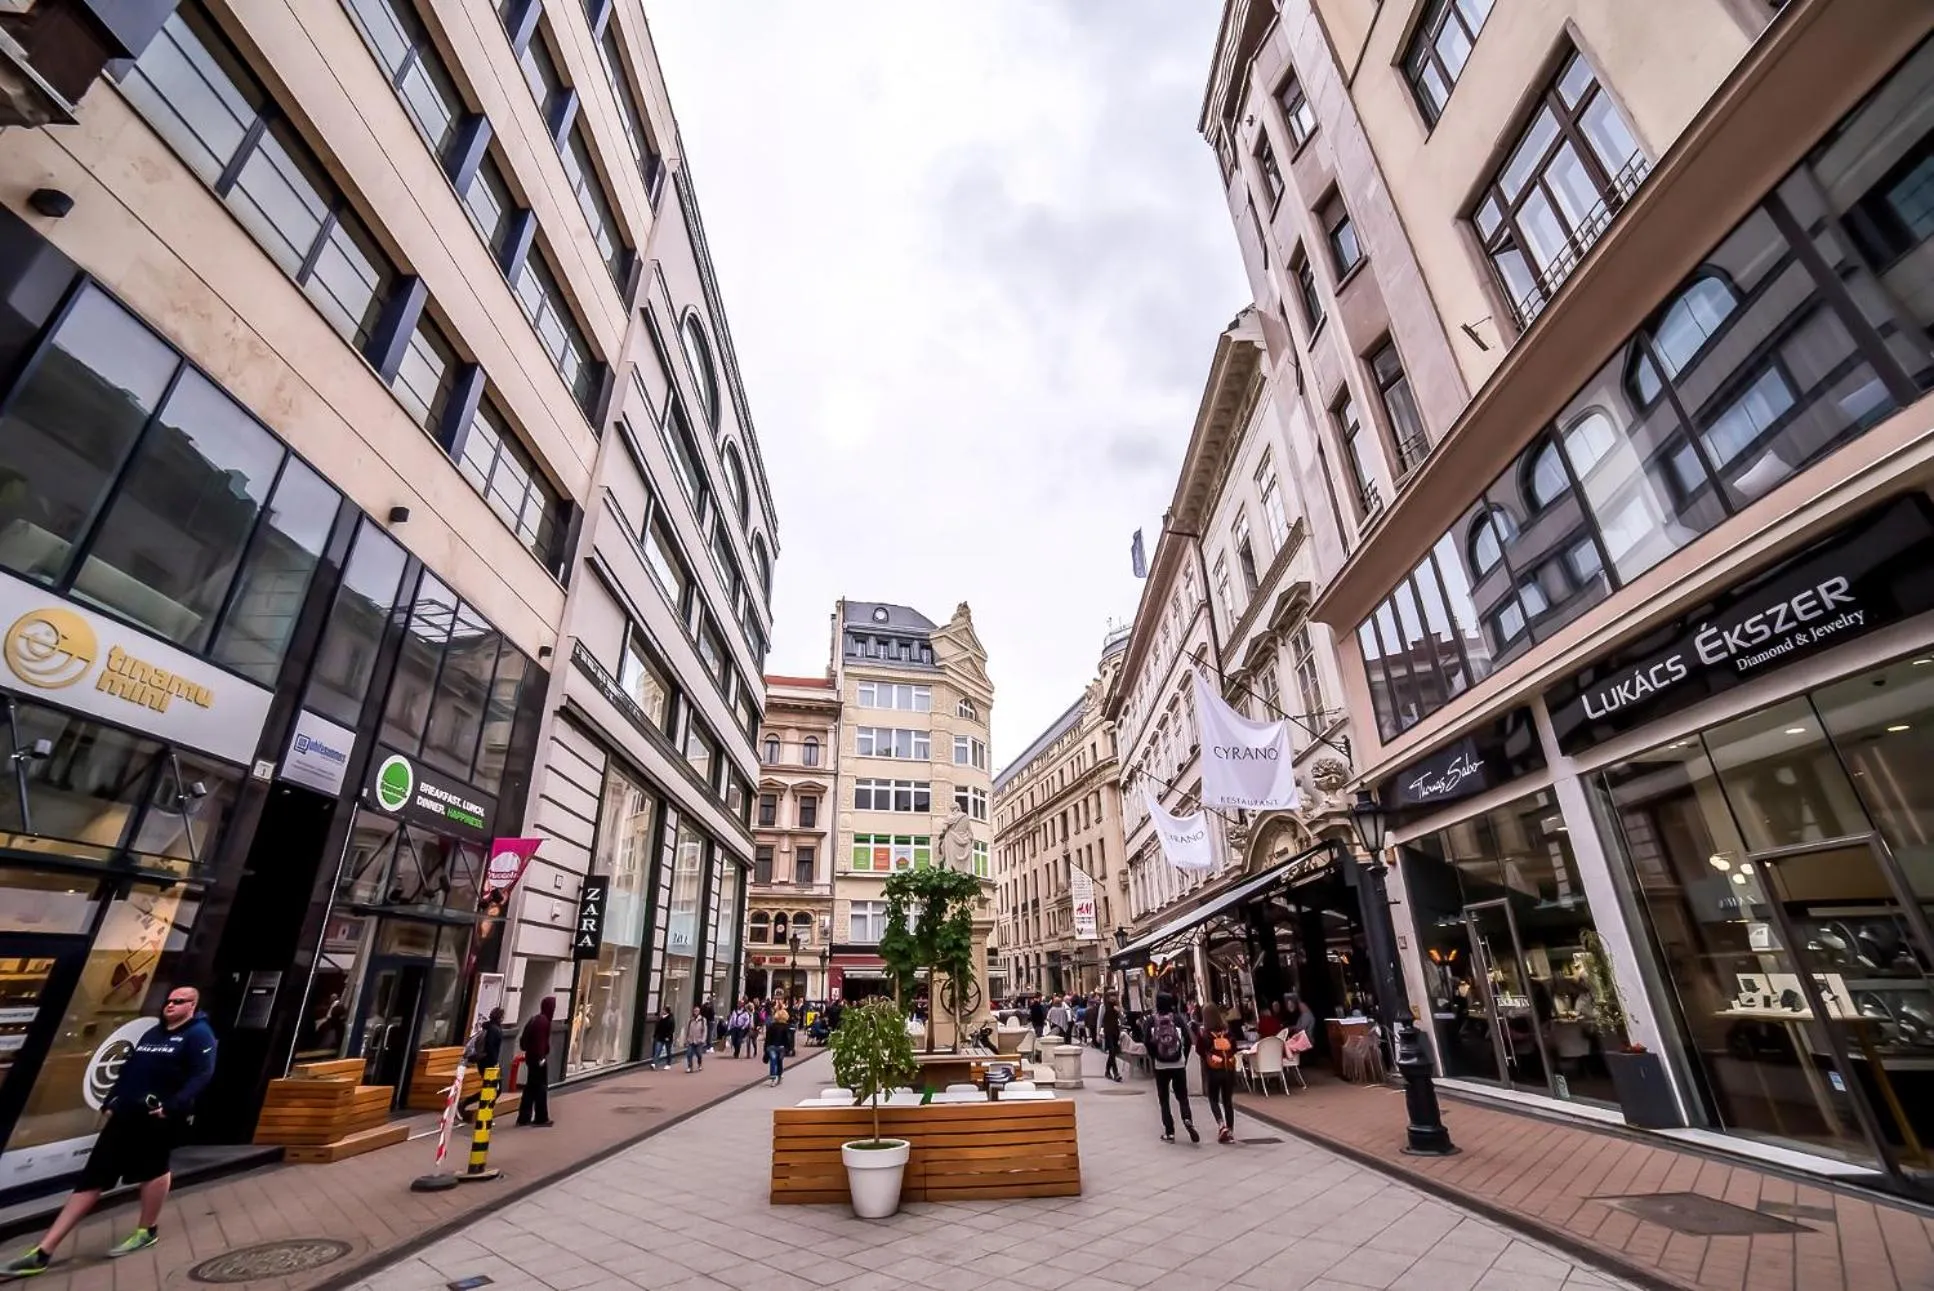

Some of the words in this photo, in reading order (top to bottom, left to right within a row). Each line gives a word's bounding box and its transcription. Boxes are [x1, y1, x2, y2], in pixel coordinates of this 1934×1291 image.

[1582, 654, 1688, 720] LUKÁCS
[1694, 575, 1856, 665] ÉKSZER
[1735, 637, 1794, 672] Diamond
[1796, 632, 1809, 646] &
[1809, 608, 1865, 643] Jewelry
[95, 671, 173, 713] mini
[107, 644, 216, 710] tinamu
[1213, 746, 1279, 761] CYRANO
[1444, 752, 1485, 793] Sabo
[1220, 796, 1279, 807] RESTAURANT
[577, 888, 601, 947] ZARA
